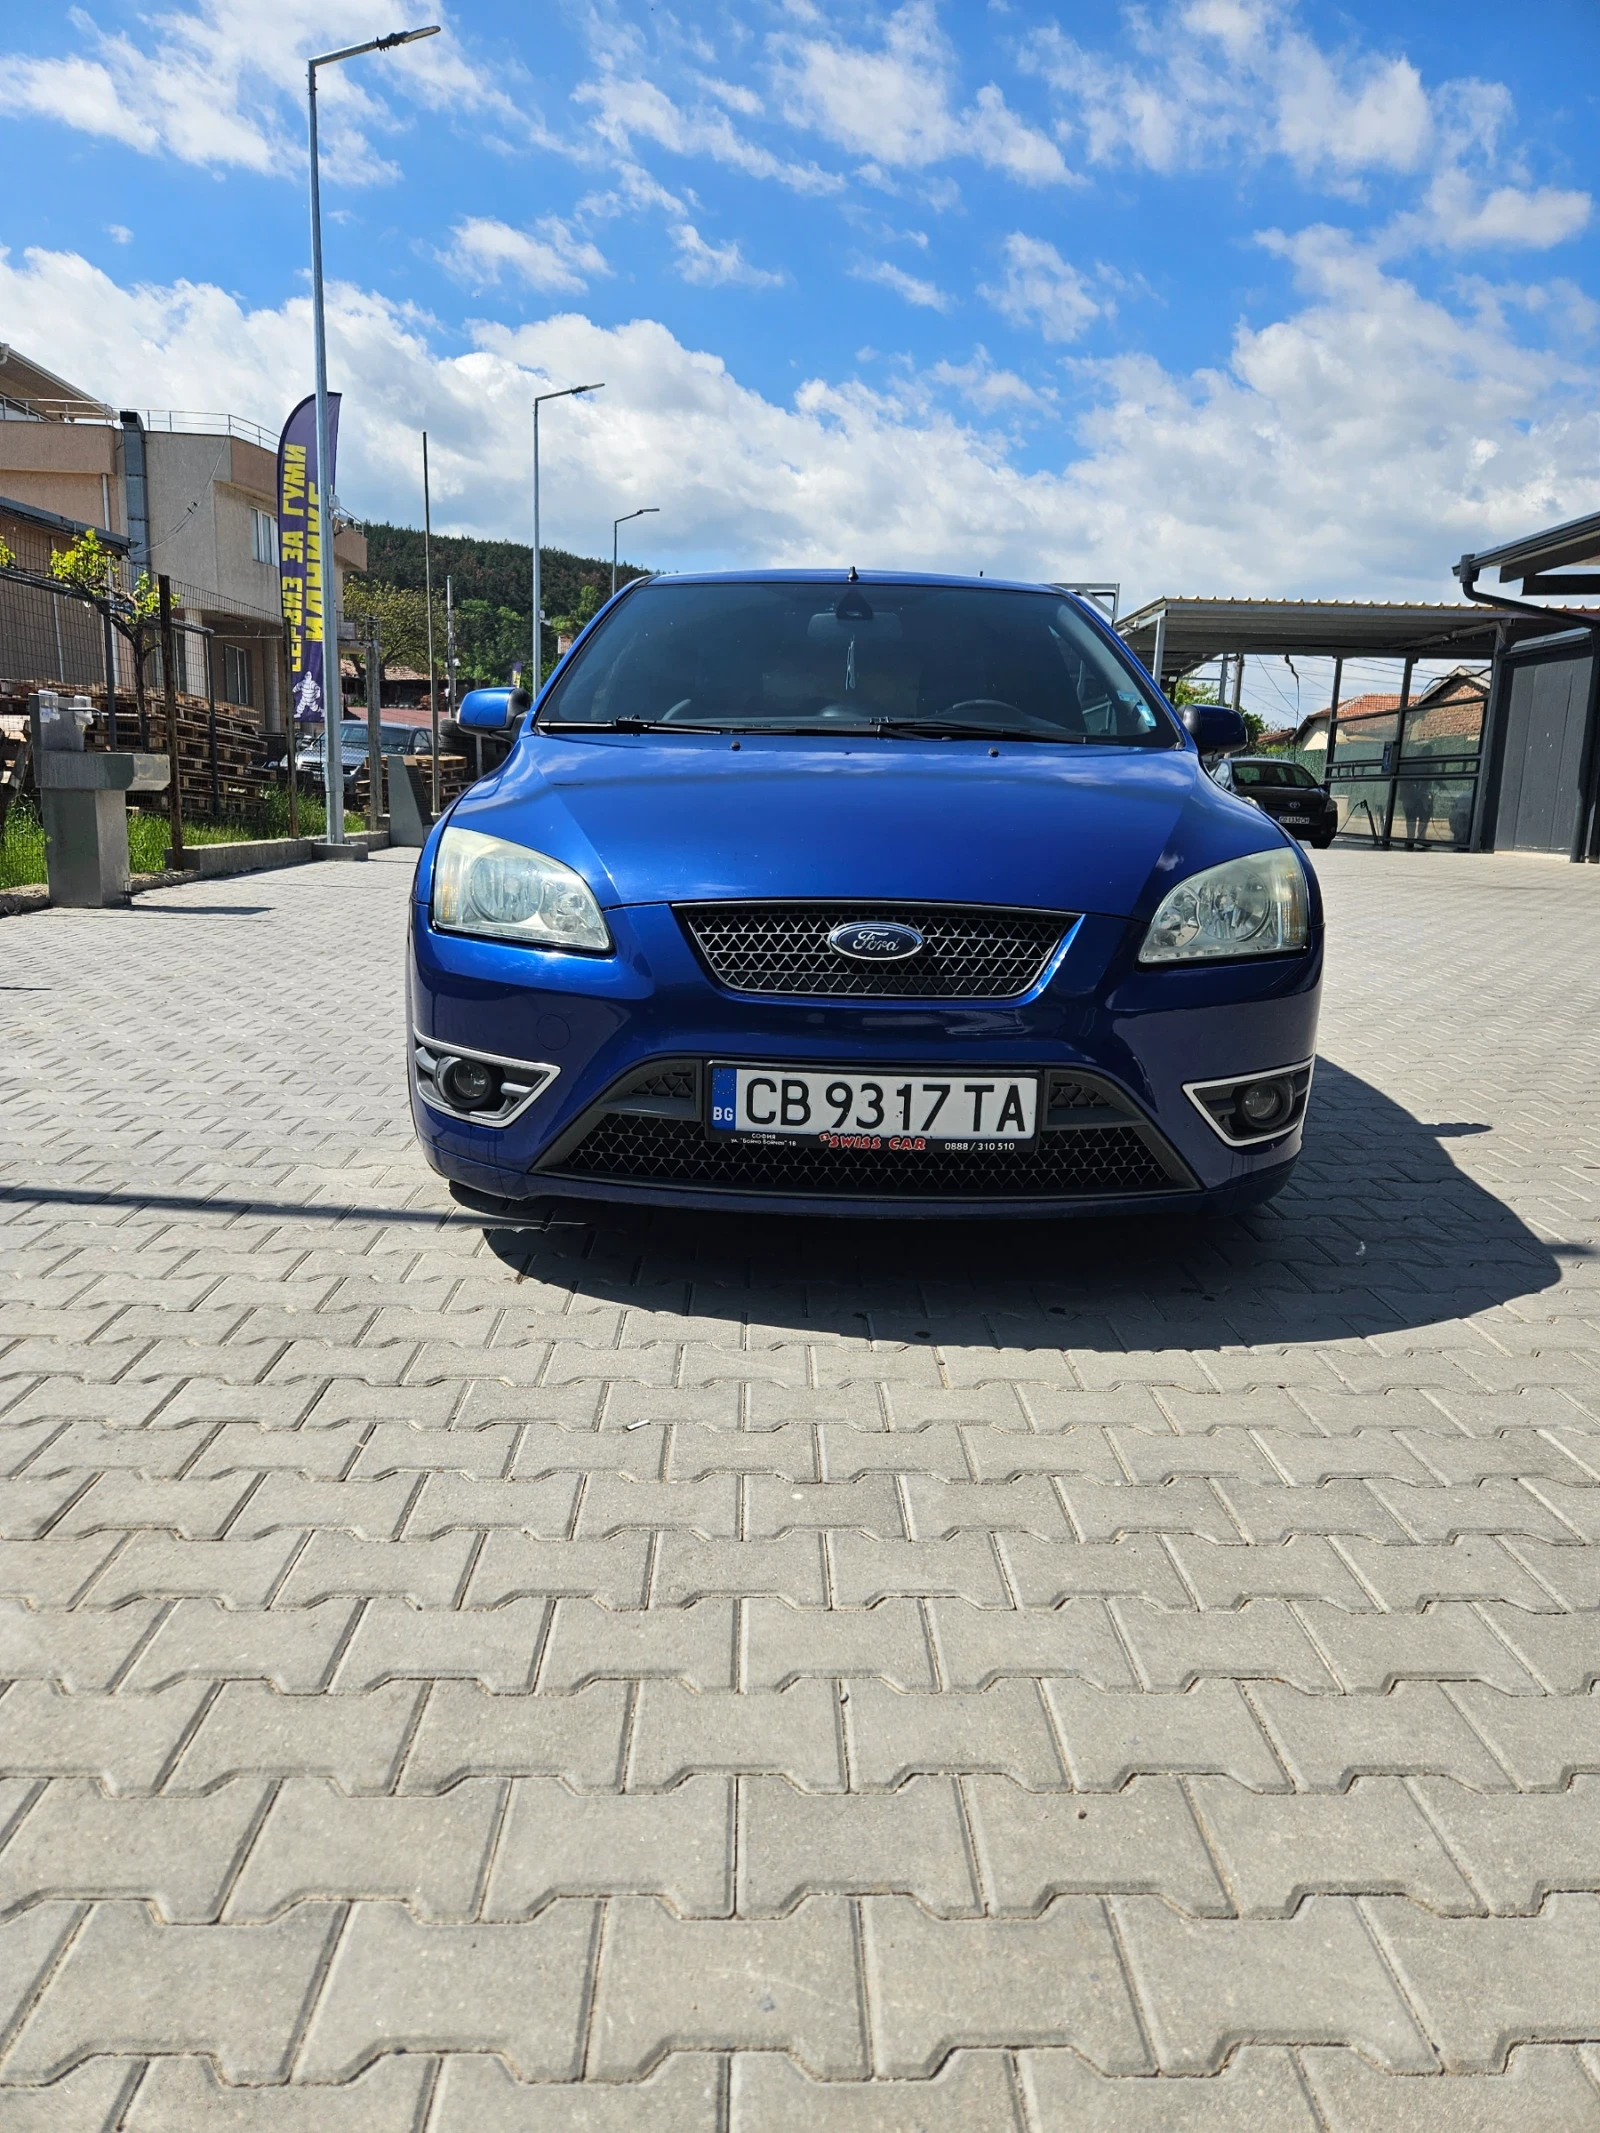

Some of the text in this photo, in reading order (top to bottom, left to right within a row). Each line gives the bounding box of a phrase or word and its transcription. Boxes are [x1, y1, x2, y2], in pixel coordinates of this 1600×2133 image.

[283, 443, 307, 517] ГУМИ
[282, 531, 304, 564] ЗА
[852, 930, 900, 951] Ford
[712, 1106, 734, 1121] BG
[746, 1077, 1026, 1132] CB 9317 TA
[751, 1132, 777, 1140] СОФИЯ
[828, 1134, 927, 1150] SWISS CAR
[944, 1142, 969, 1151] 0888
[977, 1142, 995, 1151] 310
[997, 1142, 1016, 1151] 510
